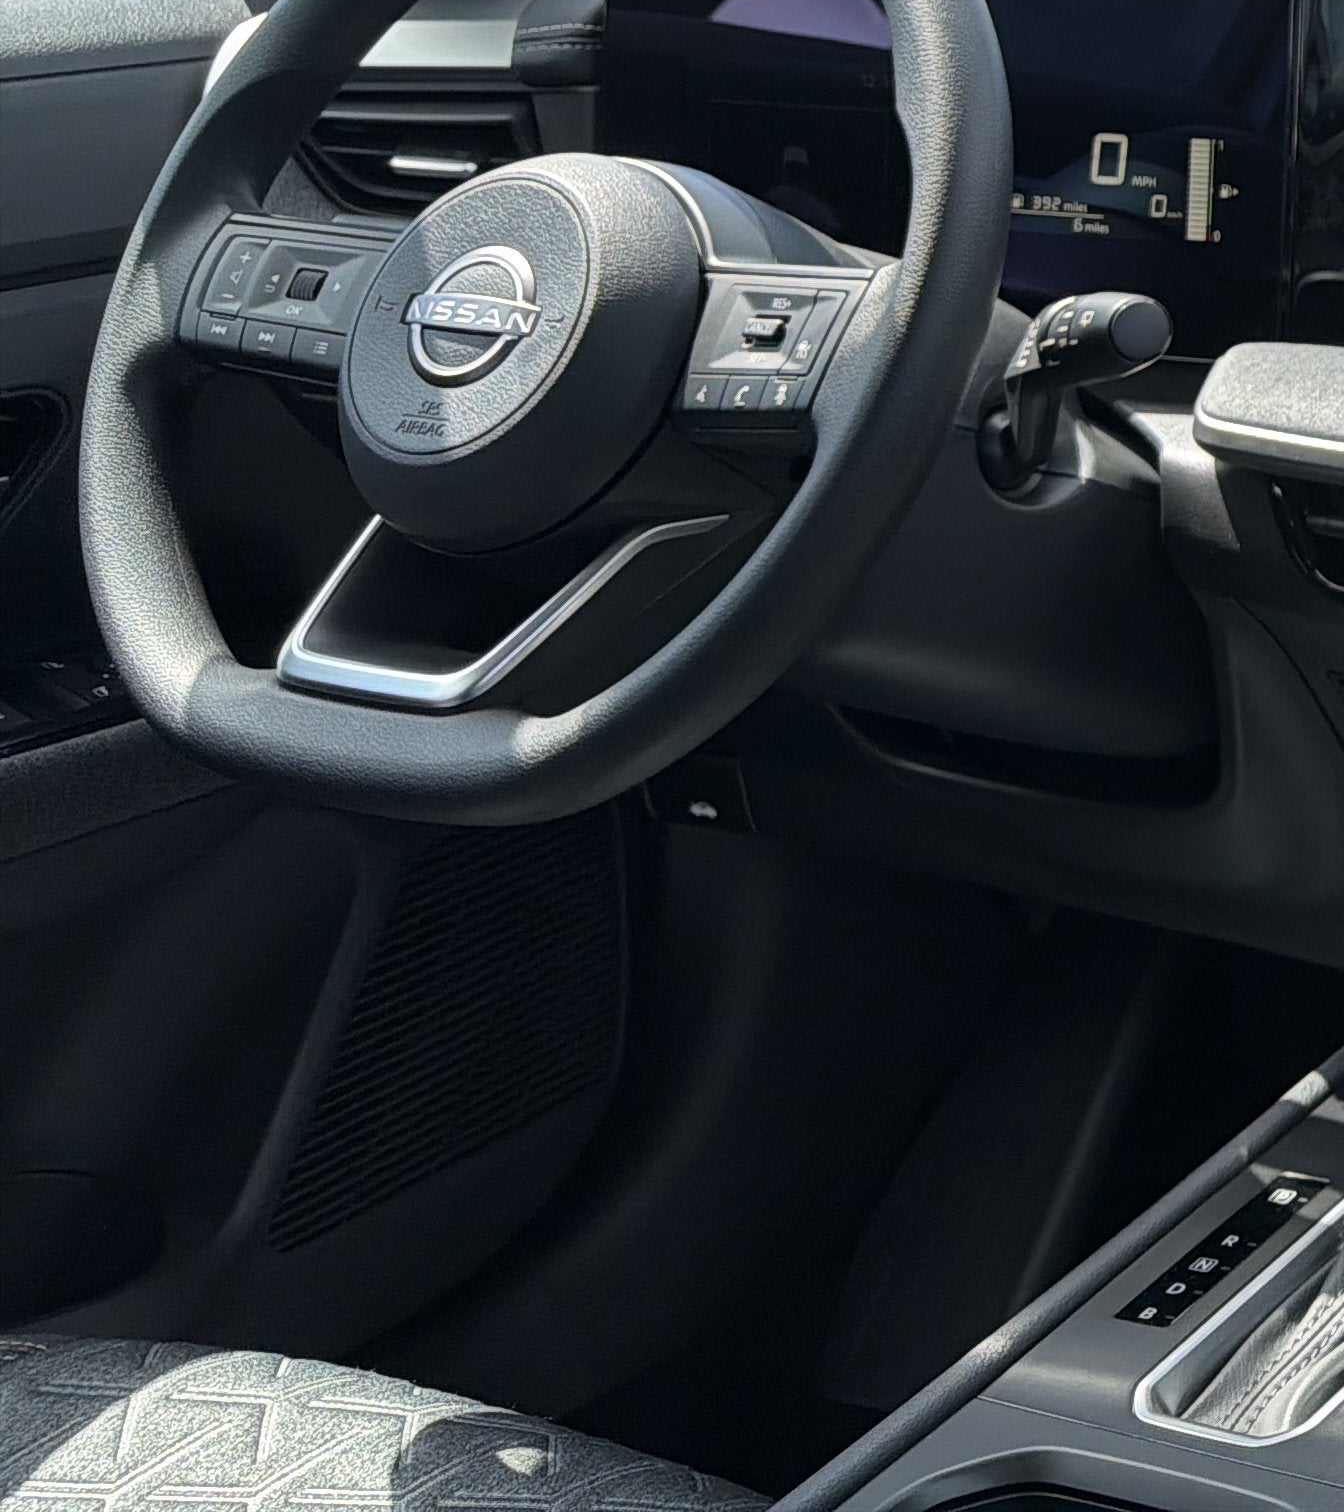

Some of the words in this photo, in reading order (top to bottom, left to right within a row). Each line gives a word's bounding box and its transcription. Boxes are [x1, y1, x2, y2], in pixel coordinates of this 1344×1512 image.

[1090, 132, 1129, 185] 0
[1131, 175, 1157, 188] MPH
[1032, 195, 1062, 211] 392
[1063, 201, 1088, 213] miles
[1150, 194, 1168, 218] 0
[1085, 222, 1110, 234] miles
[405, 298, 537, 334] NISSAN
[1220, 1234, 1240, 1248] R
[1165, 1282, 1187, 1295] D
[1137, 1306, 1158, 1320] B
